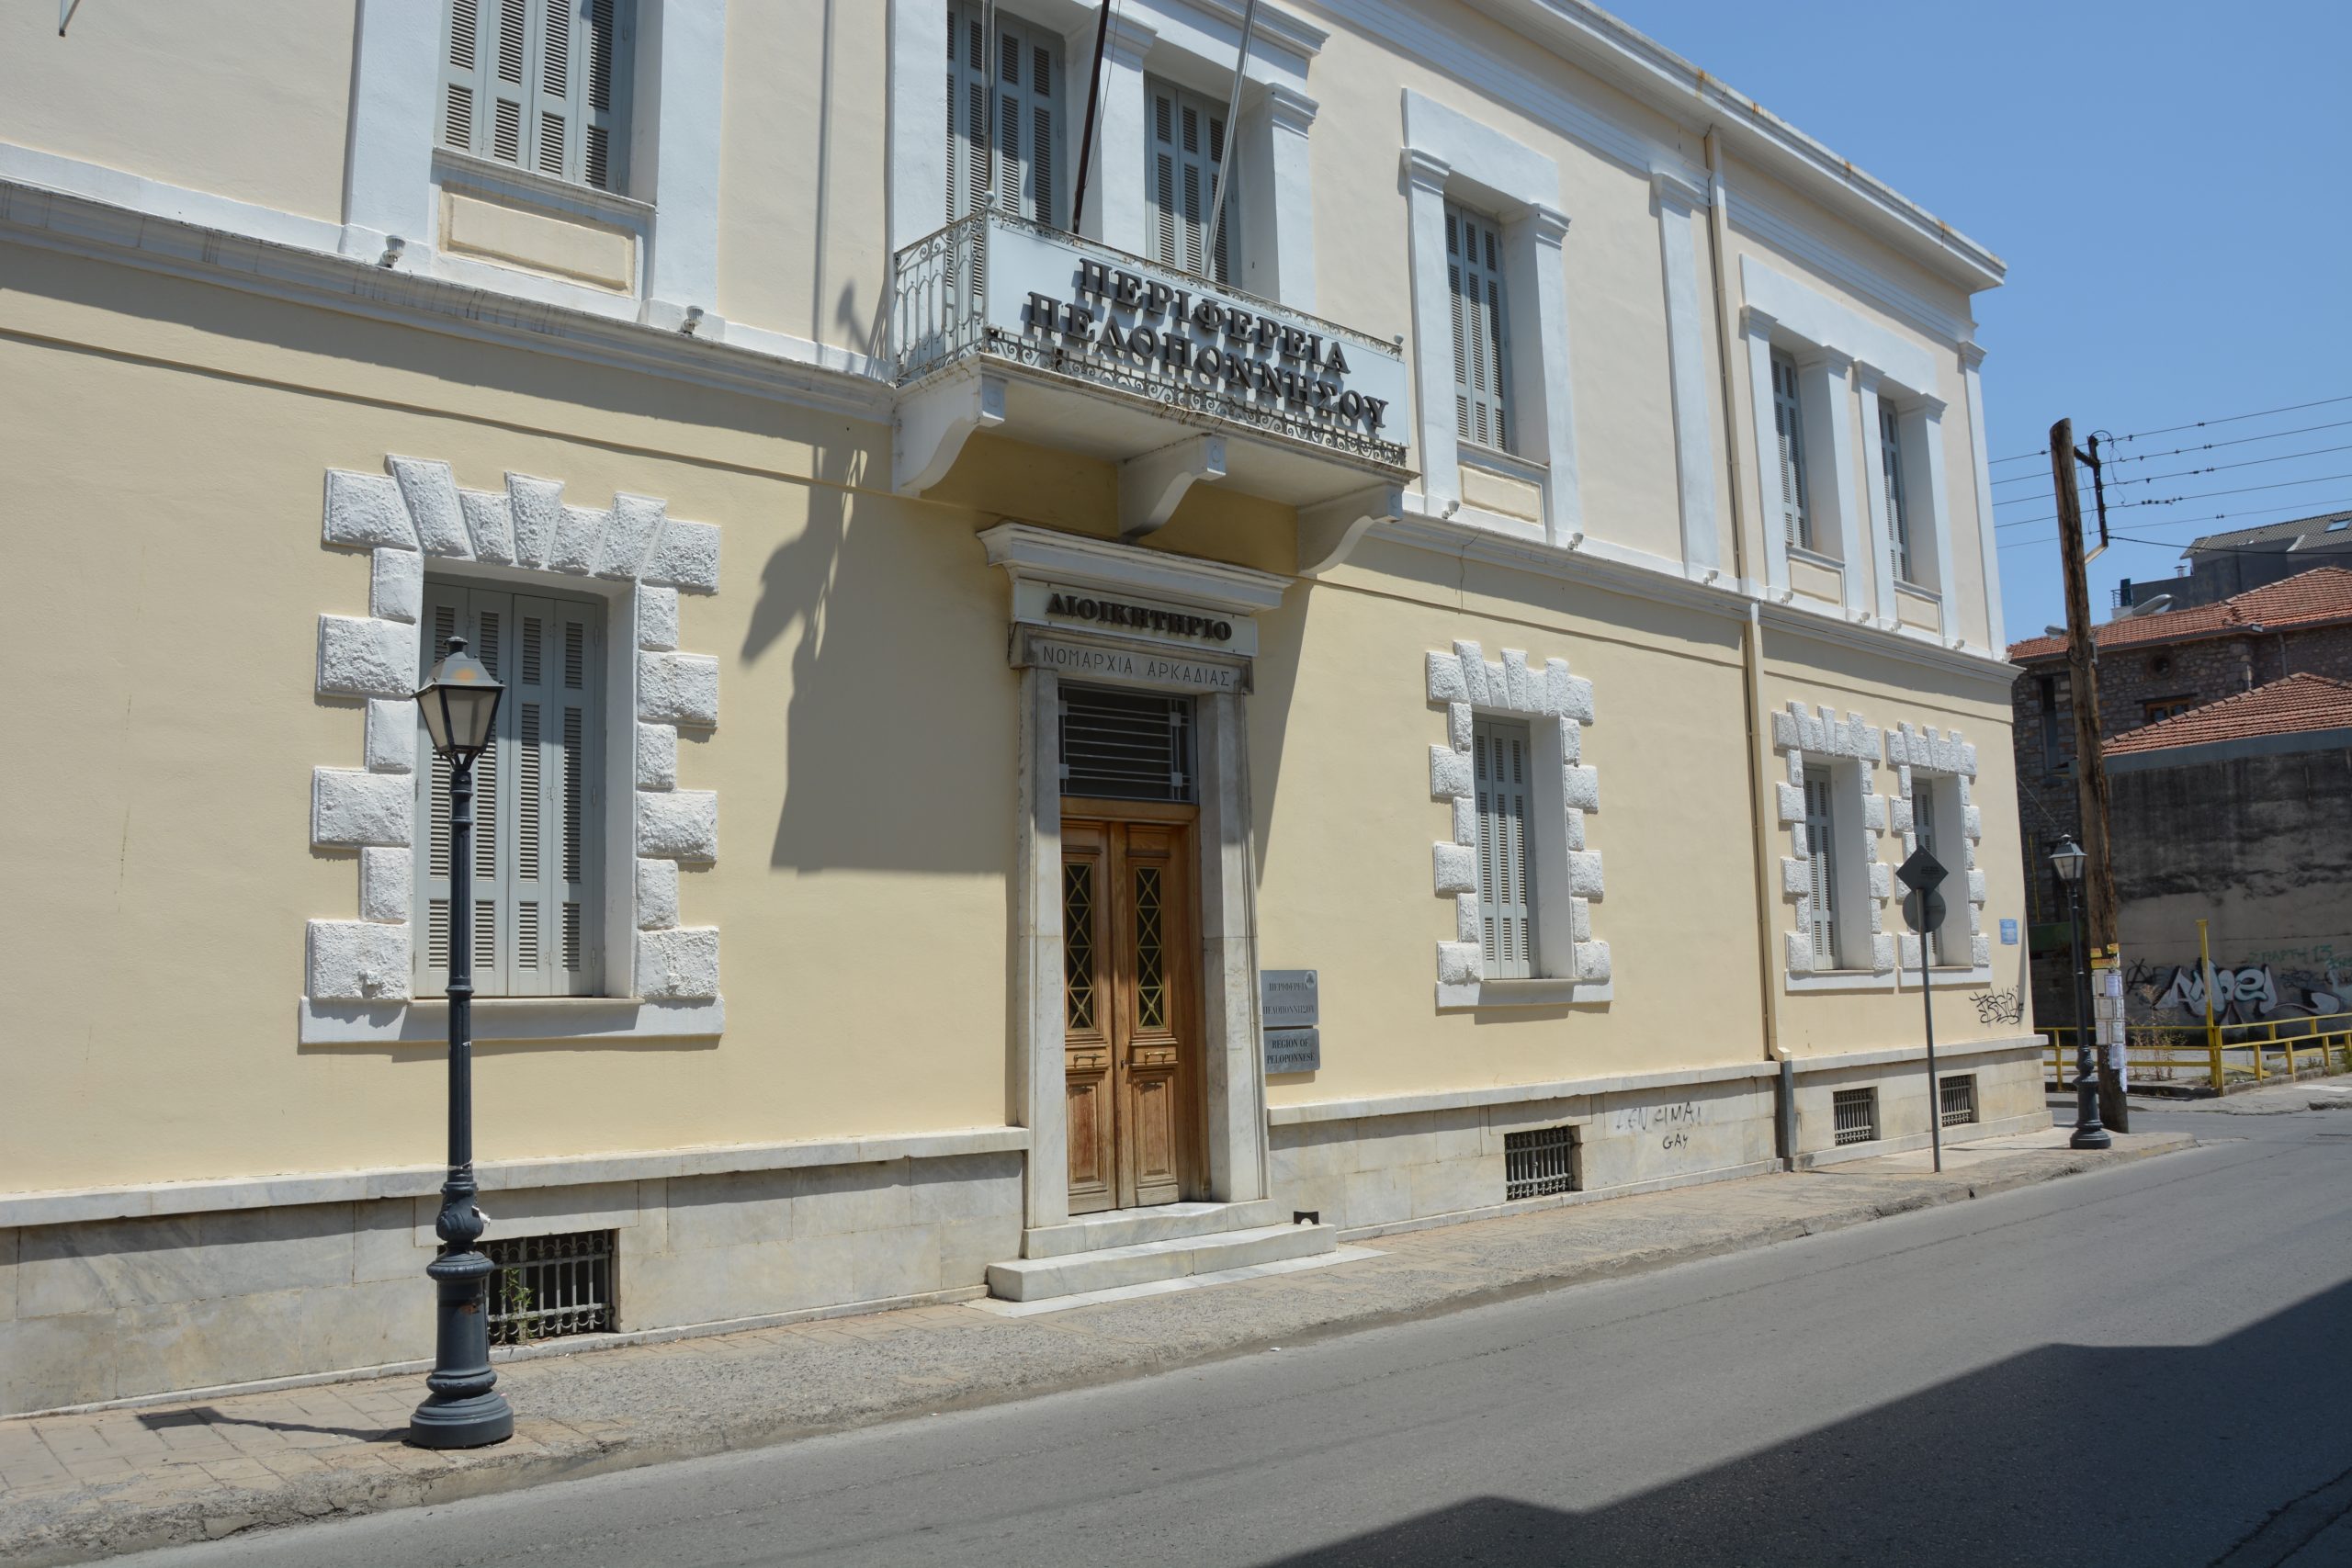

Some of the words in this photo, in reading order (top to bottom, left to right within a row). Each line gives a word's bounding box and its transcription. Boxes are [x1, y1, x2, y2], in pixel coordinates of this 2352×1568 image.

[1079, 257, 1351, 375] ΠΕΡΙΦΕΡΕΙΑ
[1026, 290, 1390, 429] ΠΕΛΟΠΟΝΝΗΣΟΥ
[1045, 592, 1233, 641] ΔΙΟΙΚΗΤΗΡΙΟ
[1043, 645, 1133, 675] ΝΟΜΑΡΧΙΑ
[1148, 660, 1230, 687] ΑΡΚΑΔΙΑΣ
[1266, 1052, 1315, 1065] PELOPONNESE
[1272, 1039, 1298, 1049] REGION
[1299, 1038, 1309, 1048] OF
[1662, 1133, 1689, 1150] GAY
